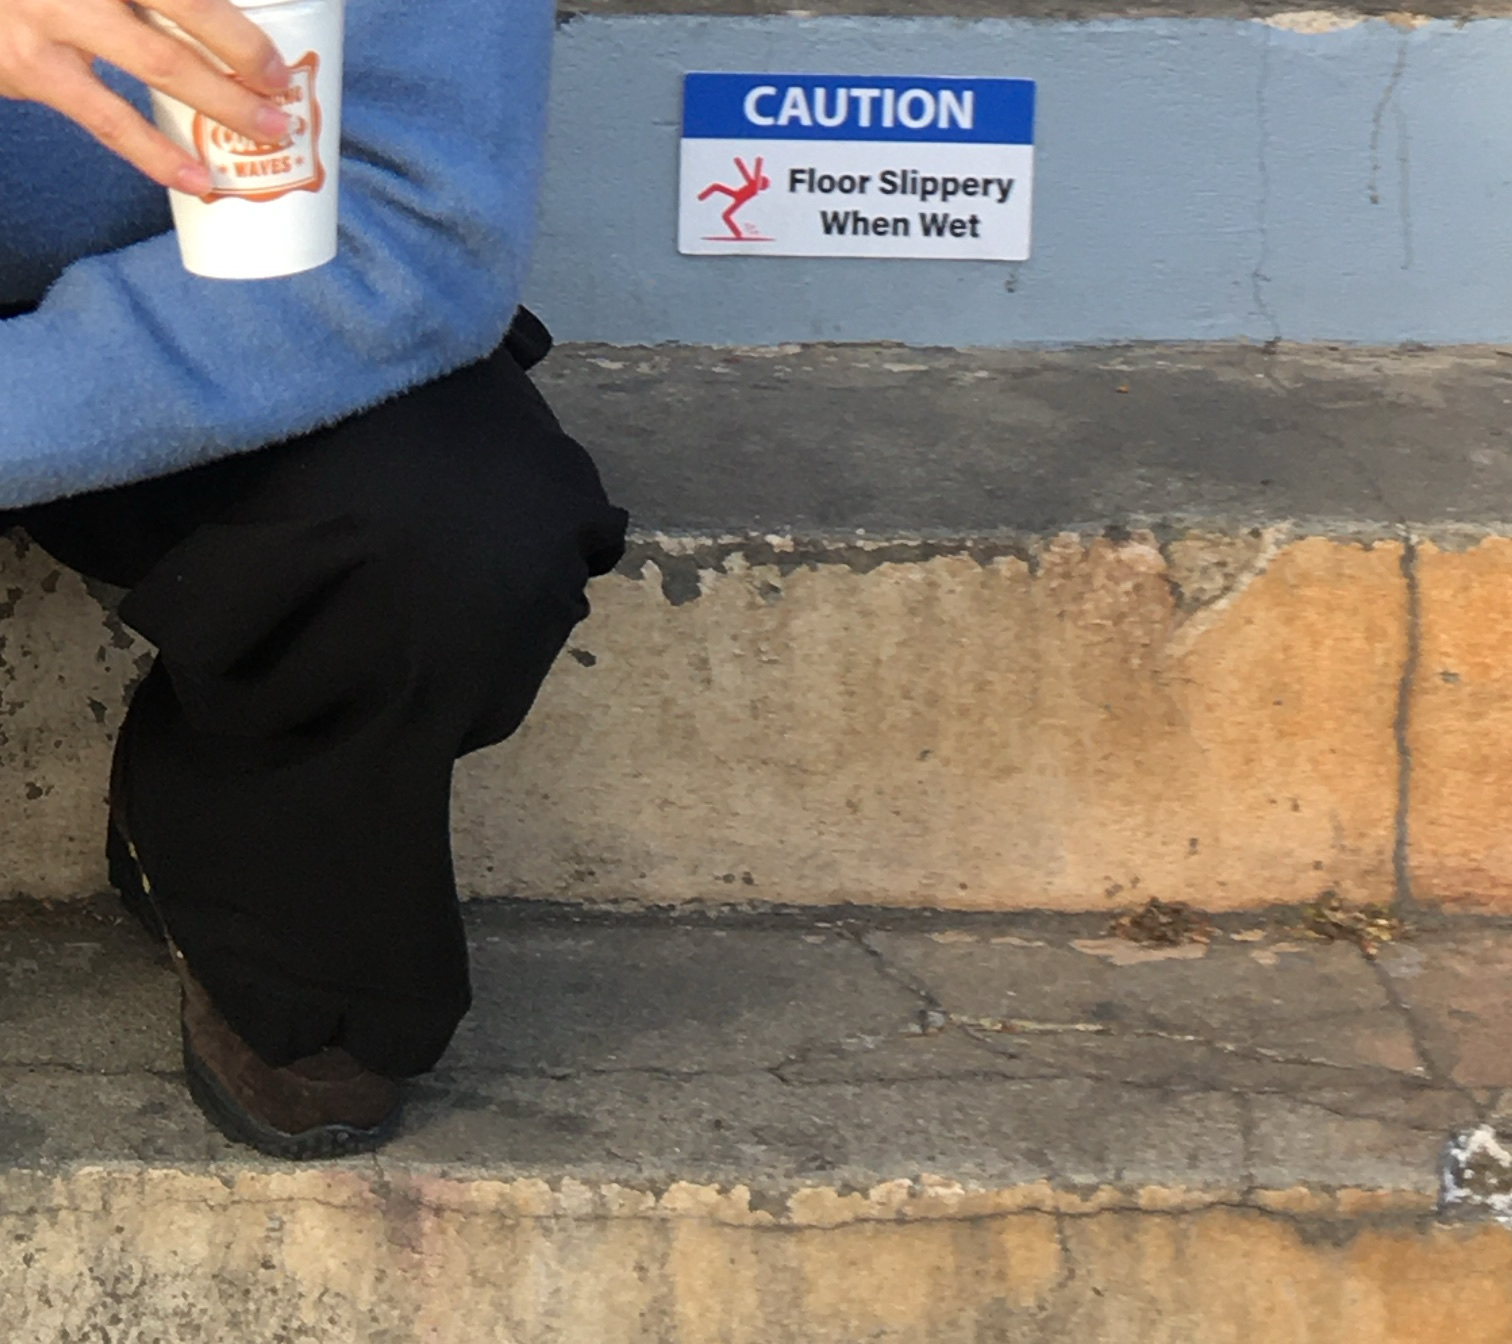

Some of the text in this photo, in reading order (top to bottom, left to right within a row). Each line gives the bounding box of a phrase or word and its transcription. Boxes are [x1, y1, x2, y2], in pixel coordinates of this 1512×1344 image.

[743, 86, 974, 130] CAUTION
[233, 155, 293, 178] WAVES
[789, 167, 1015, 204] Floor Slippery
[819, 210, 982, 238] When Wet
